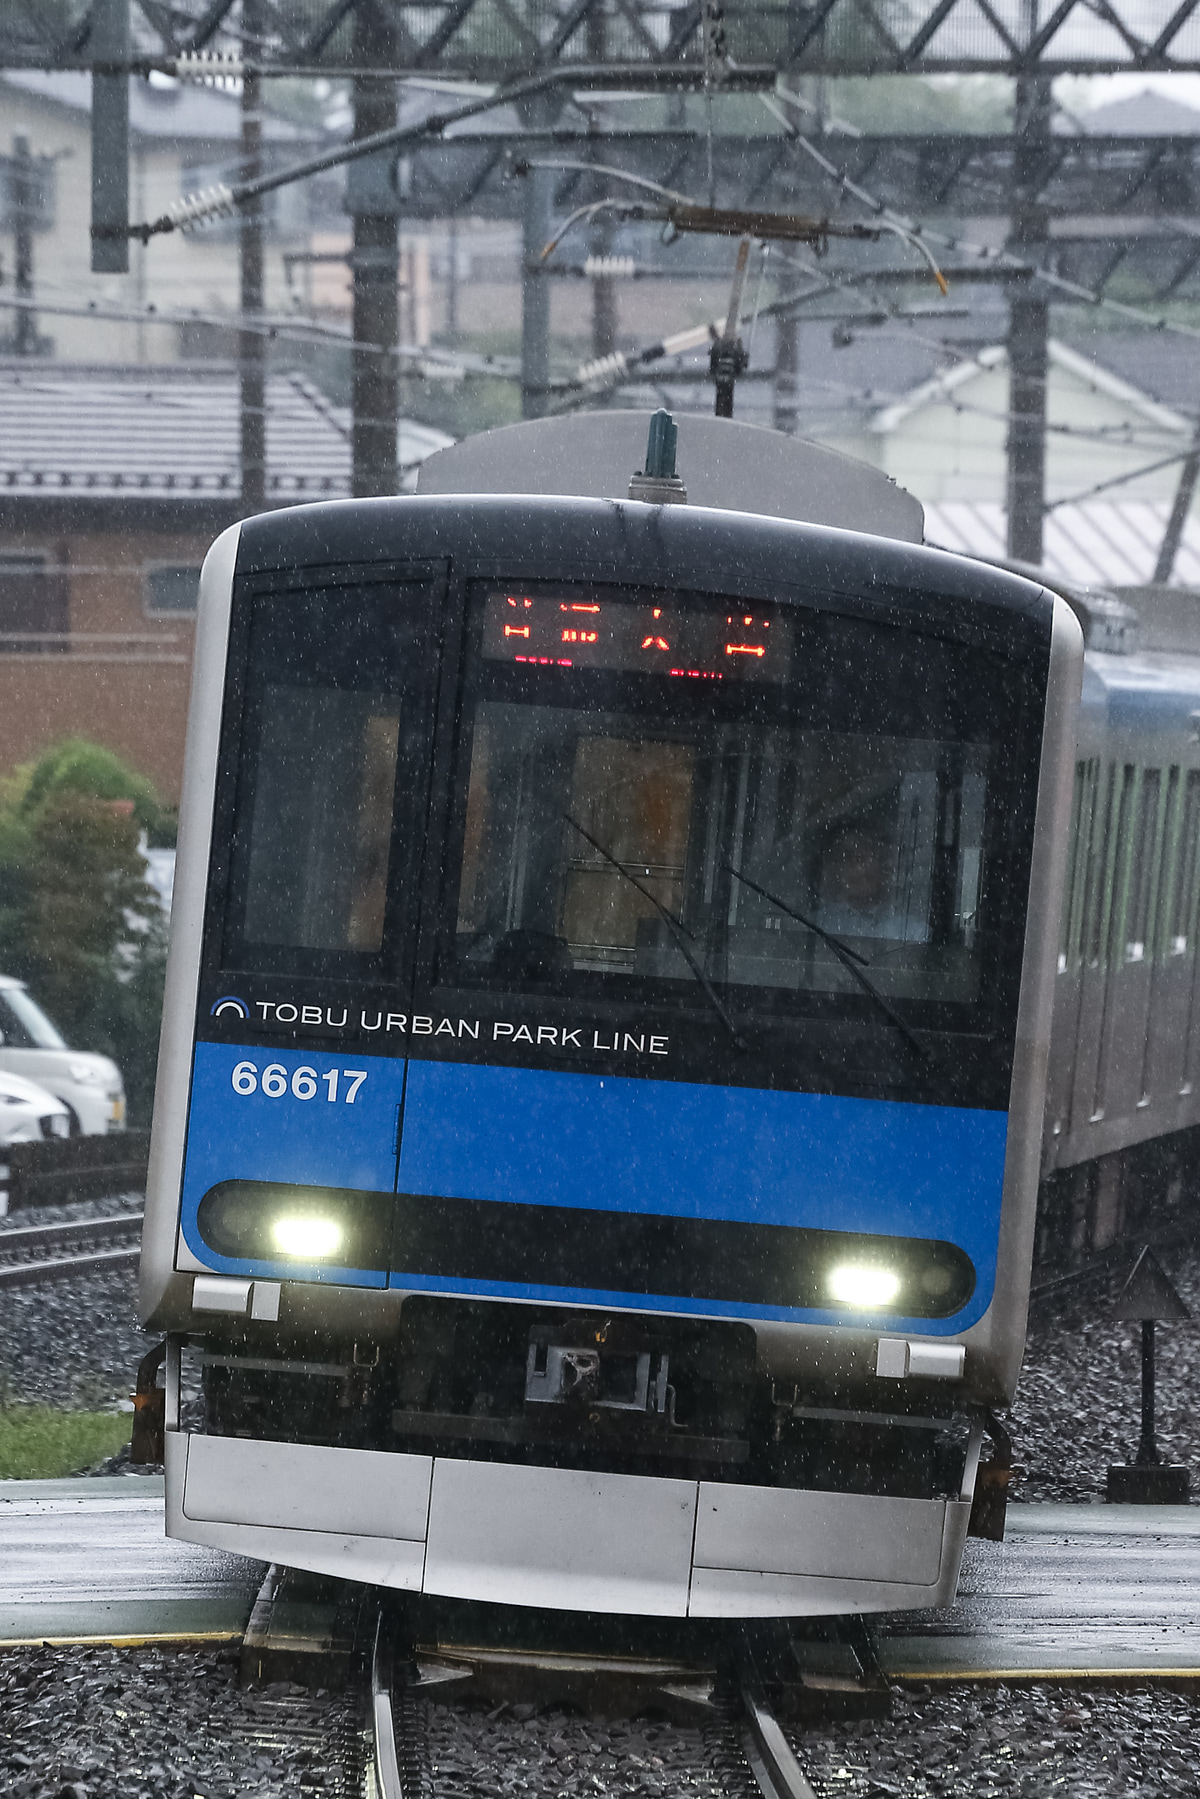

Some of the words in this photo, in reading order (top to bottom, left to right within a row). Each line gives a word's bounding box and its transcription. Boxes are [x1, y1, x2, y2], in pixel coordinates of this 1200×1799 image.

[256, 1001, 348, 1027] TOBU
[360, 1010, 480, 1039] URBAN
[492, 1022, 582, 1047] PARK
[593, 1030, 669, 1055] LINE
[231, 1061, 368, 1104] 66617
